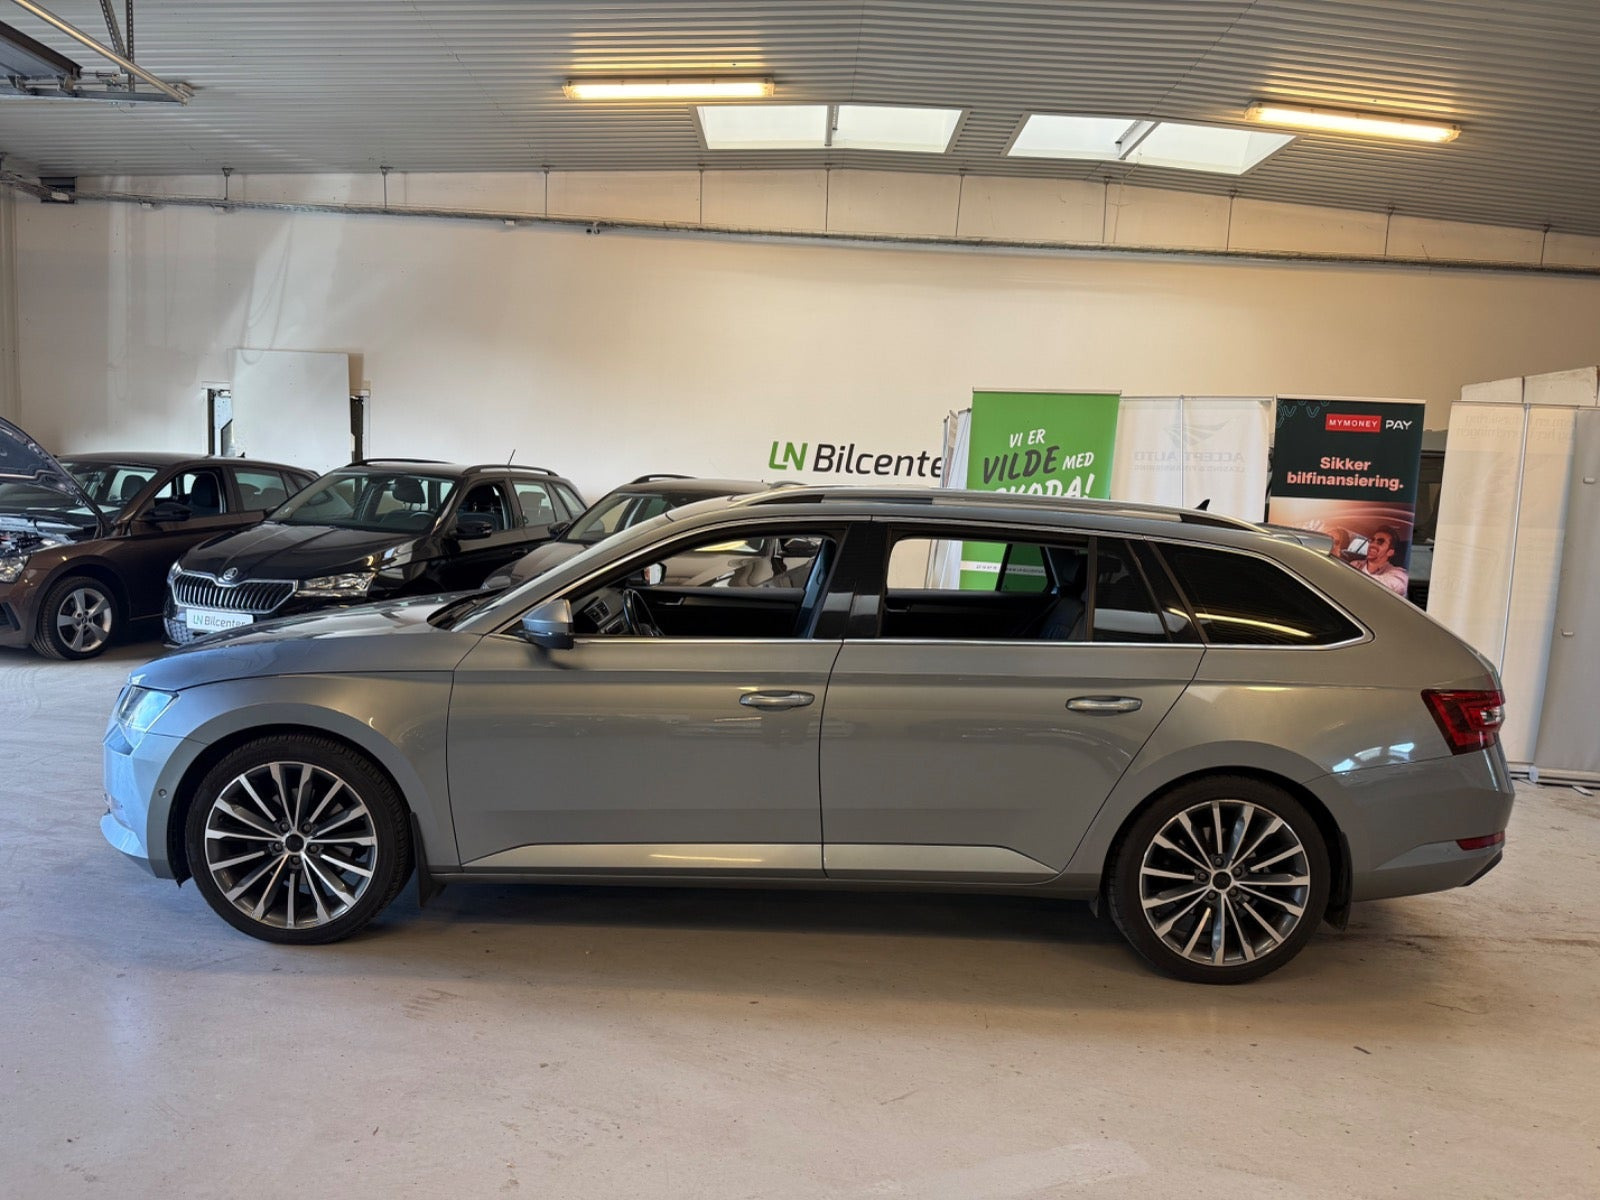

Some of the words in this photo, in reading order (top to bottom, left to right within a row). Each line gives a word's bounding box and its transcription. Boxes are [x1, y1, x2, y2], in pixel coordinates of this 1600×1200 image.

[1328, 419, 1378, 428] MYMONEY
[1385, 420, 1413, 430] PAY
[1009, 432, 1023, 448] VI
[1027, 428, 1046, 445] ER
[768, 440, 808, 471] LN
[983, 445, 1060, 484] VILDE
[1062, 451, 1095, 470] MED
[1320, 456, 1371, 471] Sikker
[1286, 471, 1404, 491] bilfinansiering.
[193, 615, 204, 625] LN
